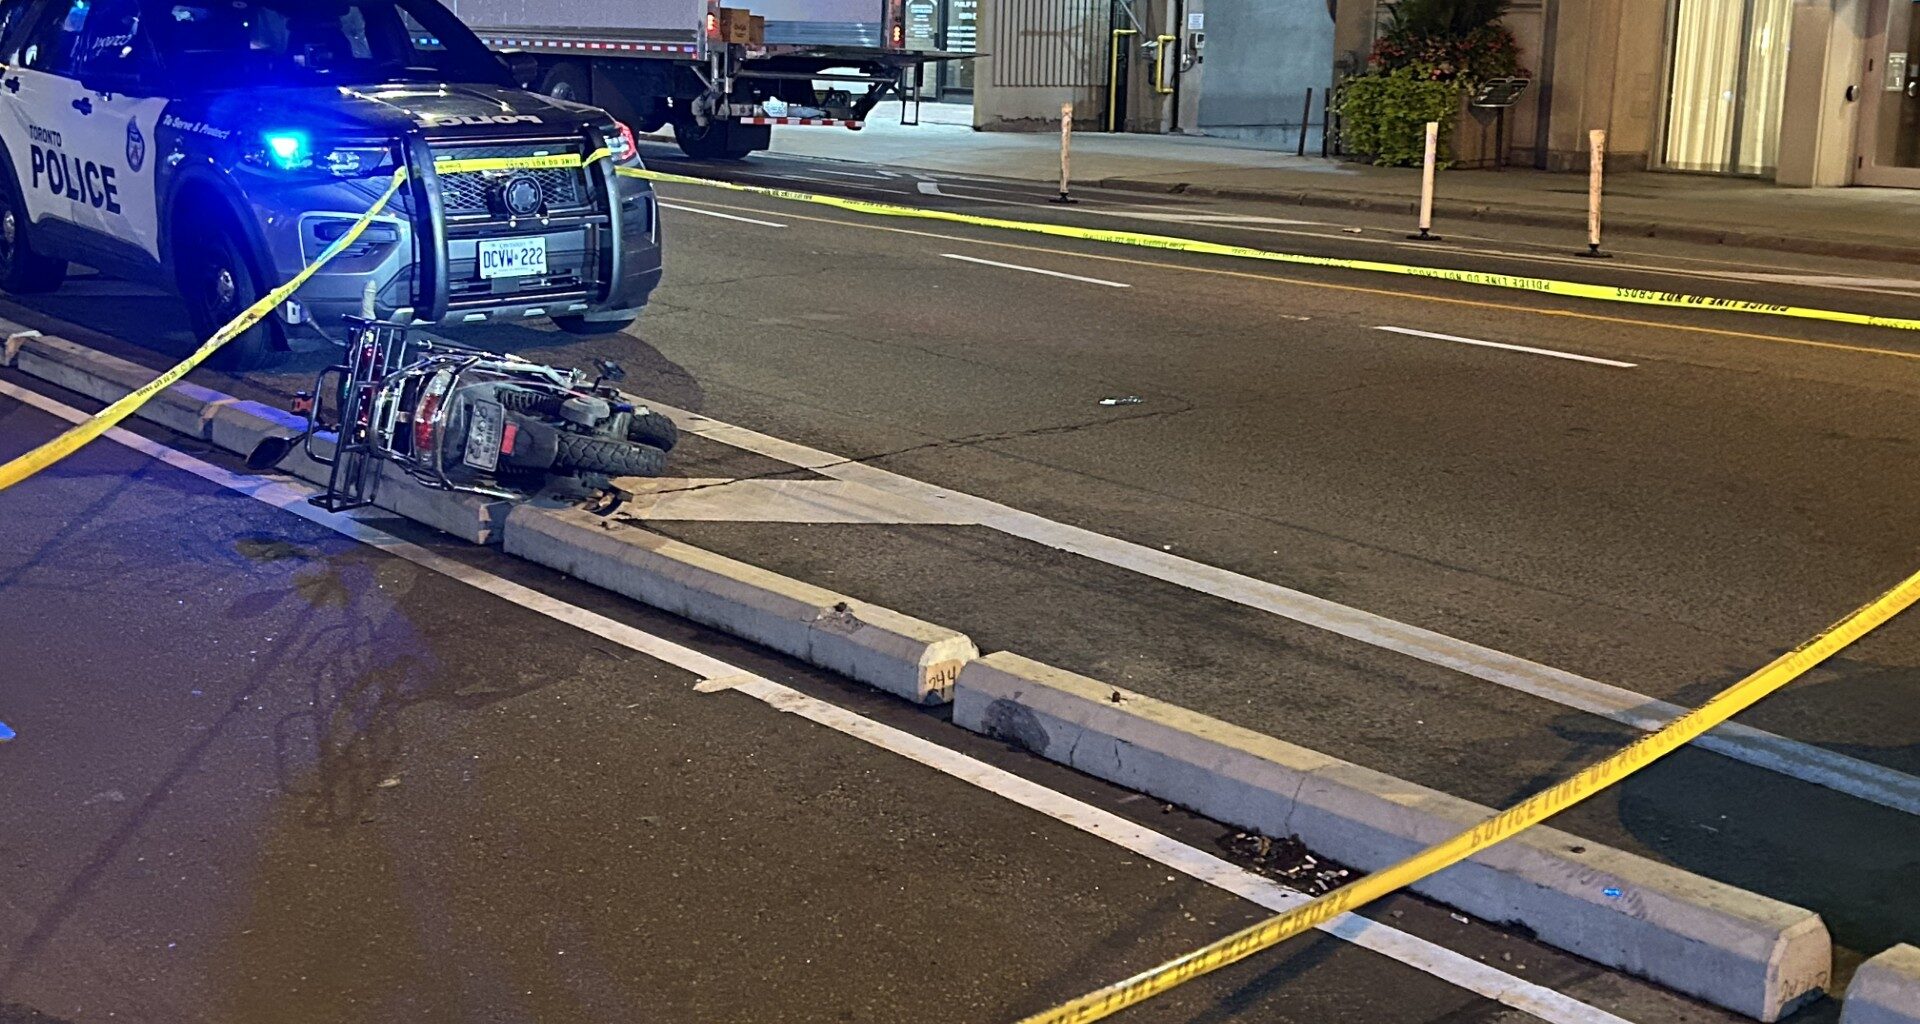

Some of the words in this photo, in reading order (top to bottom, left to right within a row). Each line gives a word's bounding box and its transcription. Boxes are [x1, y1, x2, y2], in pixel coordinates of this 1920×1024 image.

[163, 115, 173, 126] To
[172, 117, 194, 131] Serve
[199, 124, 230, 140] Protect
[29, 125, 62, 148] TORONTO
[30, 144, 121, 215] POLICE
[483, 249, 513, 269] DCVW
[520, 247, 544, 266] 222
[1484, 275, 1509, 287] LINE
[1512, 279, 1550, 292] POLICE
[1615, 287, 1655, 300] CROSS
[1658, 292, 1683, 302] NOT
[1687, 295, 1705, 304] DO
[1708, 298, 1738, 308] LINE
